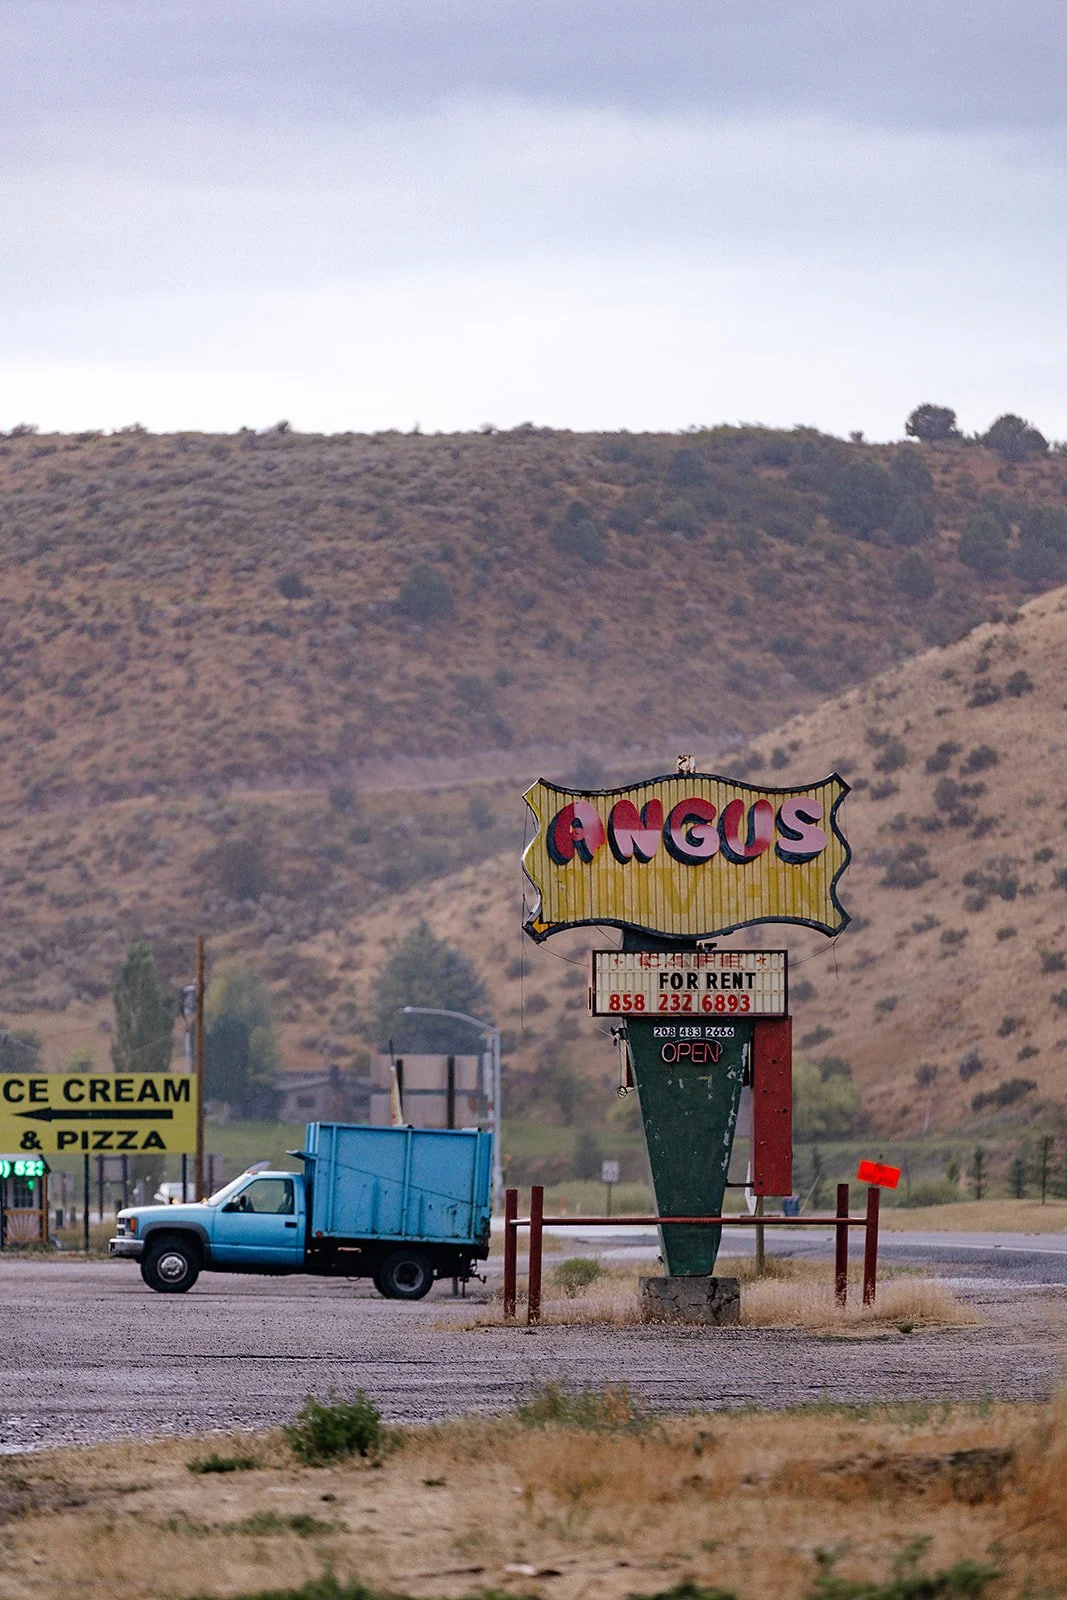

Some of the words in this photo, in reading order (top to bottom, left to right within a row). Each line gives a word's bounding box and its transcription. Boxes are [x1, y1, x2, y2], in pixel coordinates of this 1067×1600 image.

[546, 797, 828, 865] ANGUS
[659, 972, 699, 989] FOR
[706, 972, 756, 989] RENT
[609, 993, 645, 1011] 858
[658, 993, 693, 1011] 232
[701, 993, 751, 1012] 6893
[654, 1027, 676, 1037] 208
[680, 1027, 701, 1037] 483
[706, 1027, 734, 1037] 2666
[661, 1042, 720, 1063] OPEN
[63, 1079, 190, 1102] CREAM
[19, 1130, 43, 1150] &
[57, 1130, 167, 1150] PIZZA
